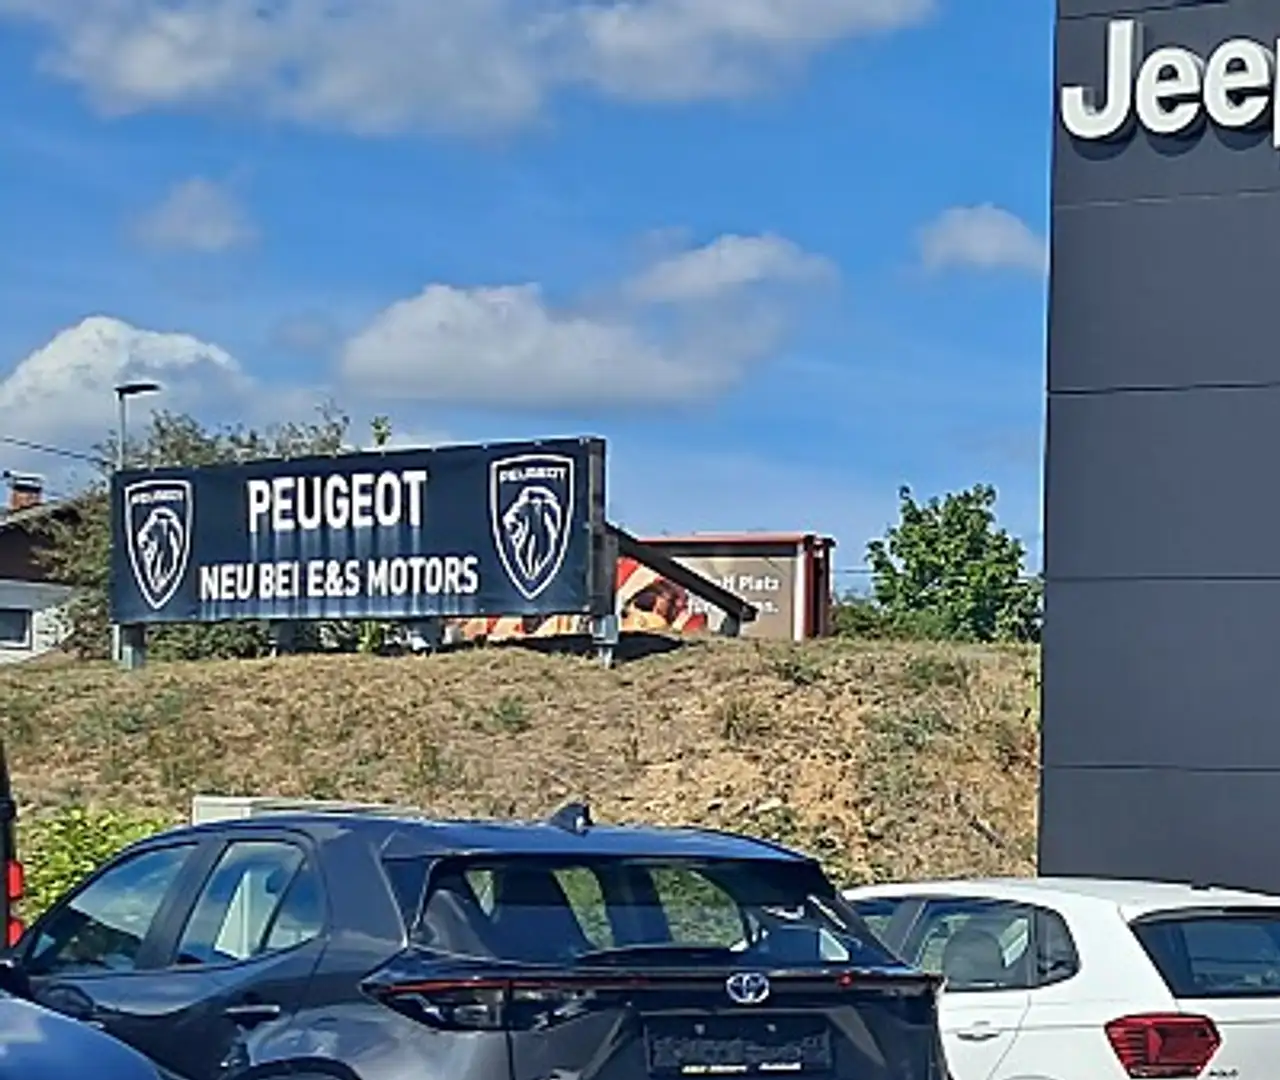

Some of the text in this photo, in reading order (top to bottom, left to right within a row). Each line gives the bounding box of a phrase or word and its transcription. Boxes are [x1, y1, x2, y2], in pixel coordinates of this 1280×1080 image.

[247, 471, 428, 533] PEUGEOT
[200, 555, 479, 601] NEU BEI E&S MOTORS
